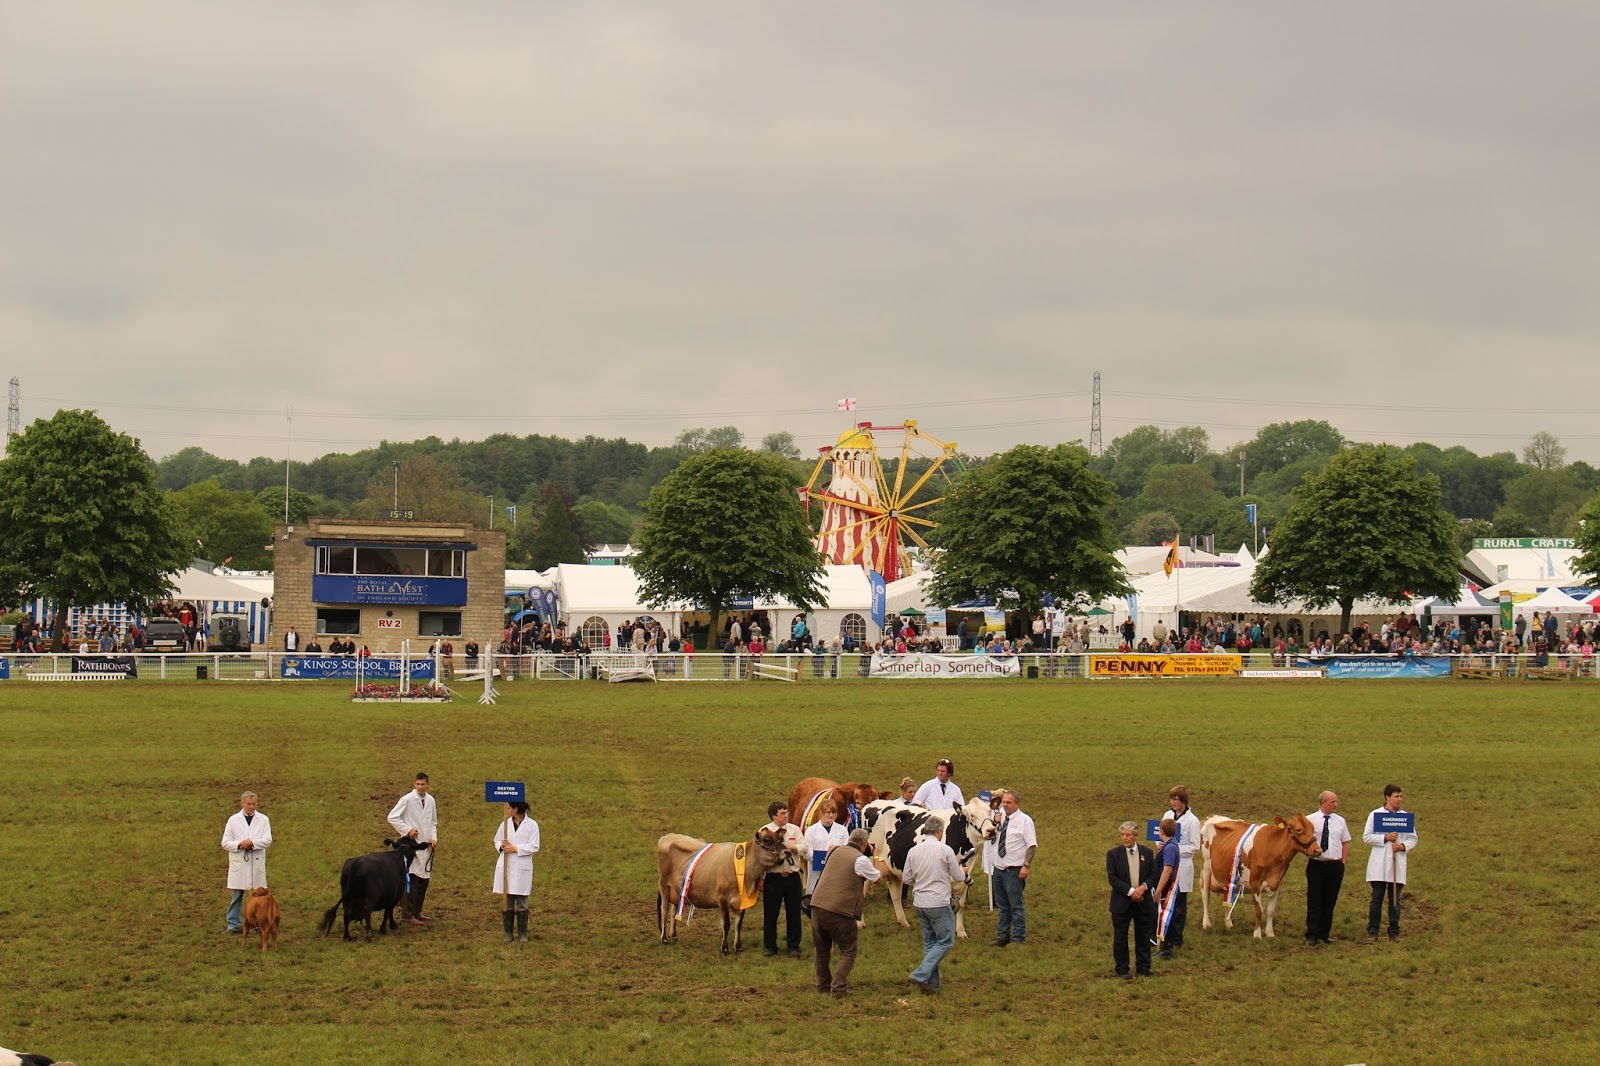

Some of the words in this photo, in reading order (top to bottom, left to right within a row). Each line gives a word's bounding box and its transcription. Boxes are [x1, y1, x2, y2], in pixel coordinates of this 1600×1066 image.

[1484, 539, 1522, 548] RURAL
[1531, 538, 1575, 548] CRAFTS
[78, 660, 131, 671] RATHBONES
[303, 660, 338, 669] KING'S
[880, 661, 940, 675] Somerlap
[948, 661, 1011, 675] Somerlap
[1094, 660, 1167, 673] PENNY
